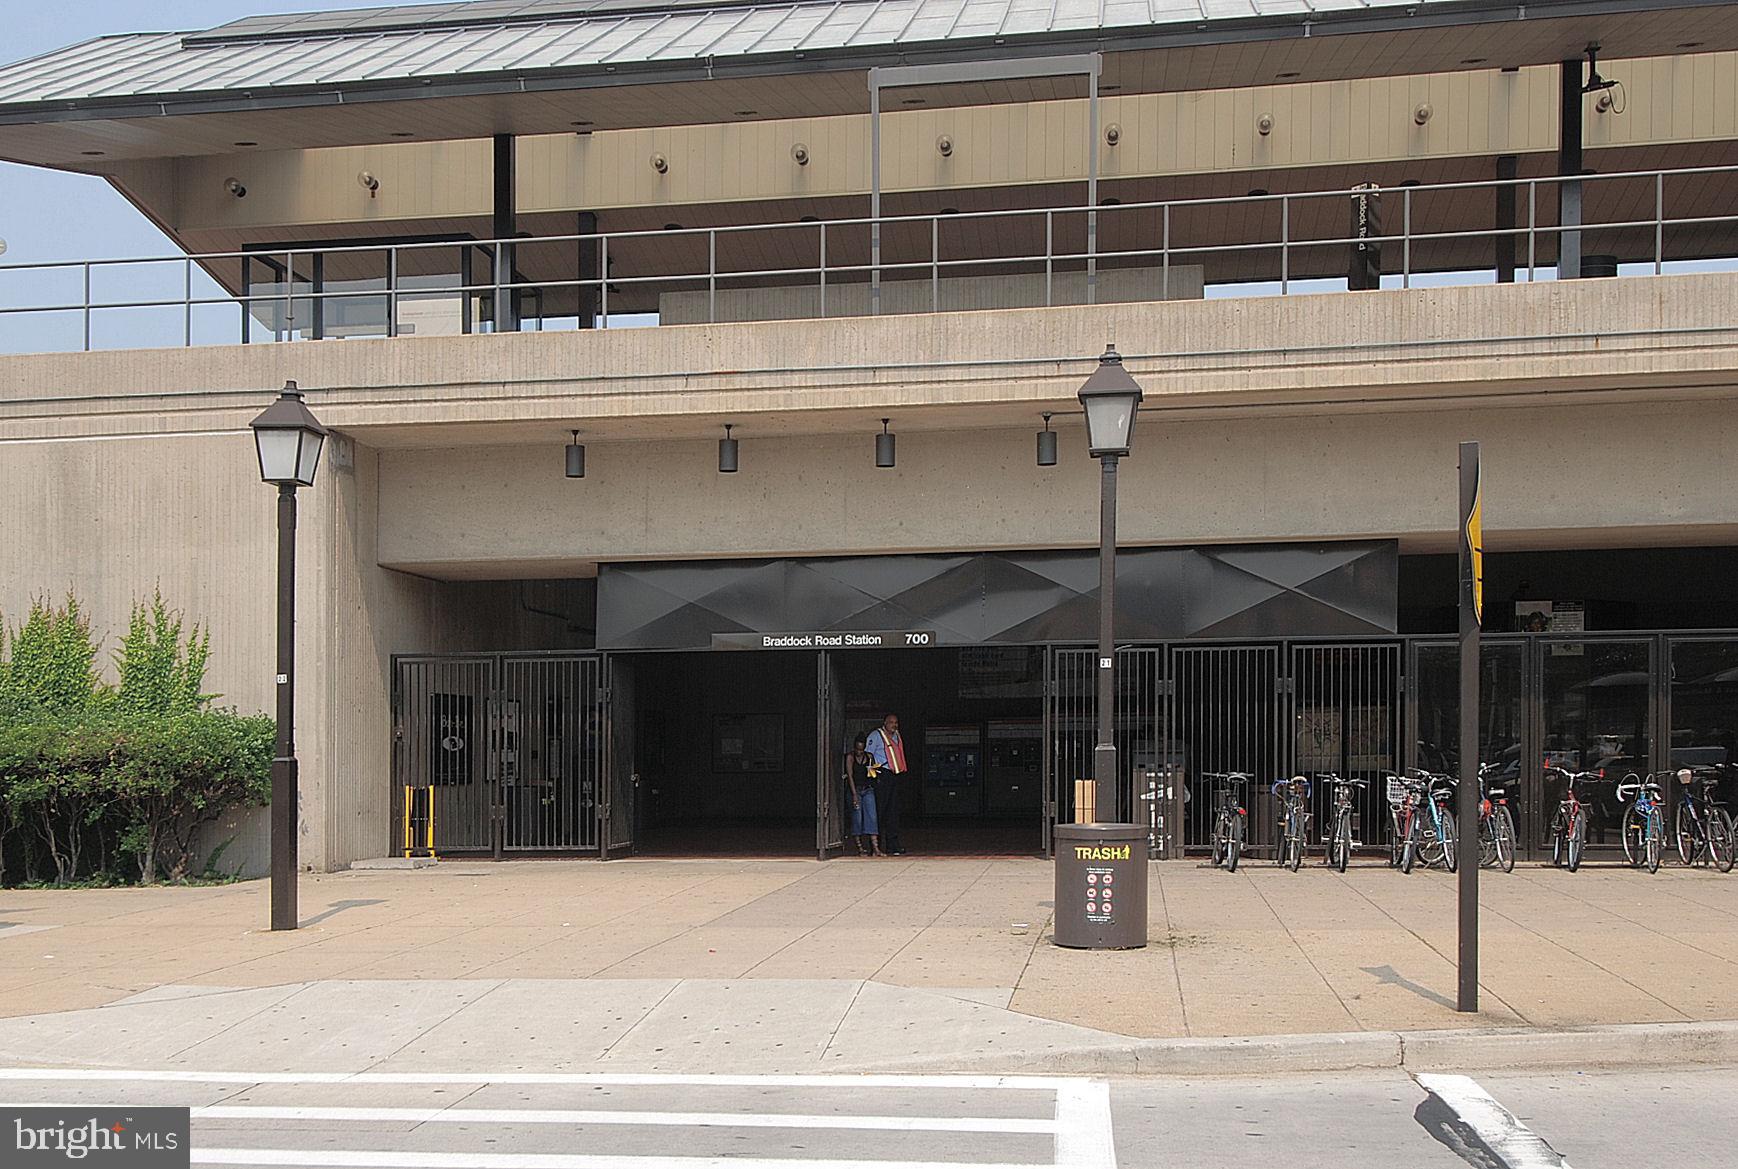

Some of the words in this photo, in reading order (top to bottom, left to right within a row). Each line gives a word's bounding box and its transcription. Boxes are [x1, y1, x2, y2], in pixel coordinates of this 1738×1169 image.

[1359, 184, 1367, 225] Baddock
[1358, 226, 1366, 251] Rod
[762, 635, 813, 647] Braddock
[815, 635, 842, 646] Road
[844, 634, 882, 645] Station
[905, 633, 929, 645] 700
[1075, 847, 1121, 860] TRASH
